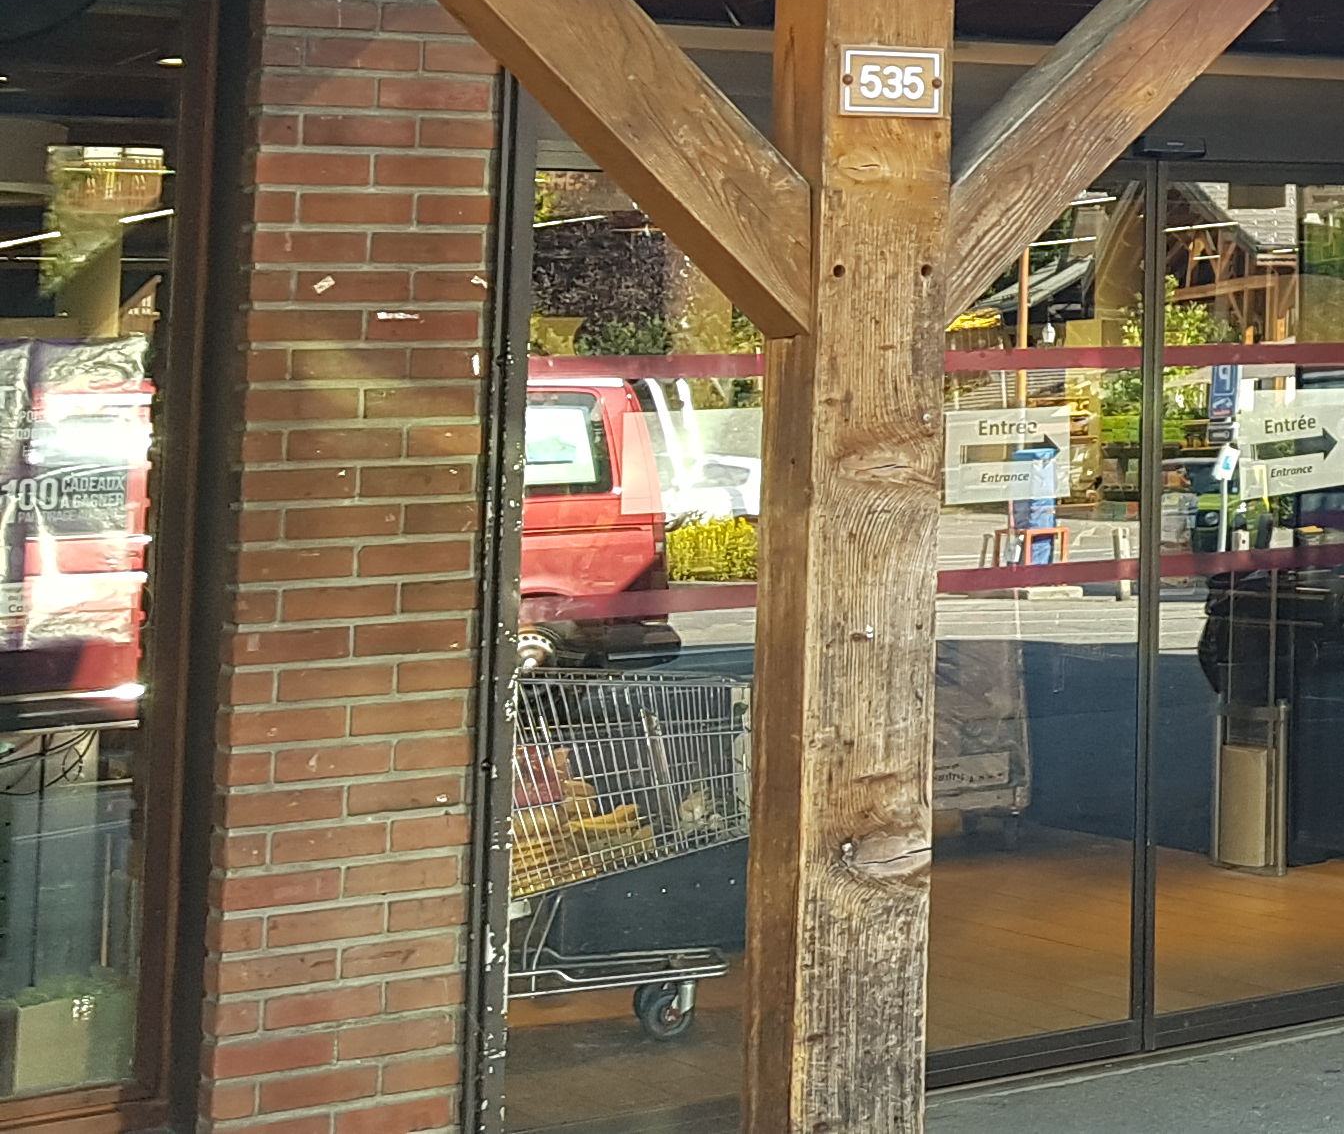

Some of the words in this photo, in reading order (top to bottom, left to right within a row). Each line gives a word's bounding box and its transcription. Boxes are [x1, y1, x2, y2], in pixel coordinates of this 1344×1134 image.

[859, 64, 925, 100] 535
[1264, 415, 1316, 434] Entrée
[980, 472, 1030, 483] Entrance
[1270, 466, 1312, 478] Entrance
[61, 476, 127, 493] CADEAUX
